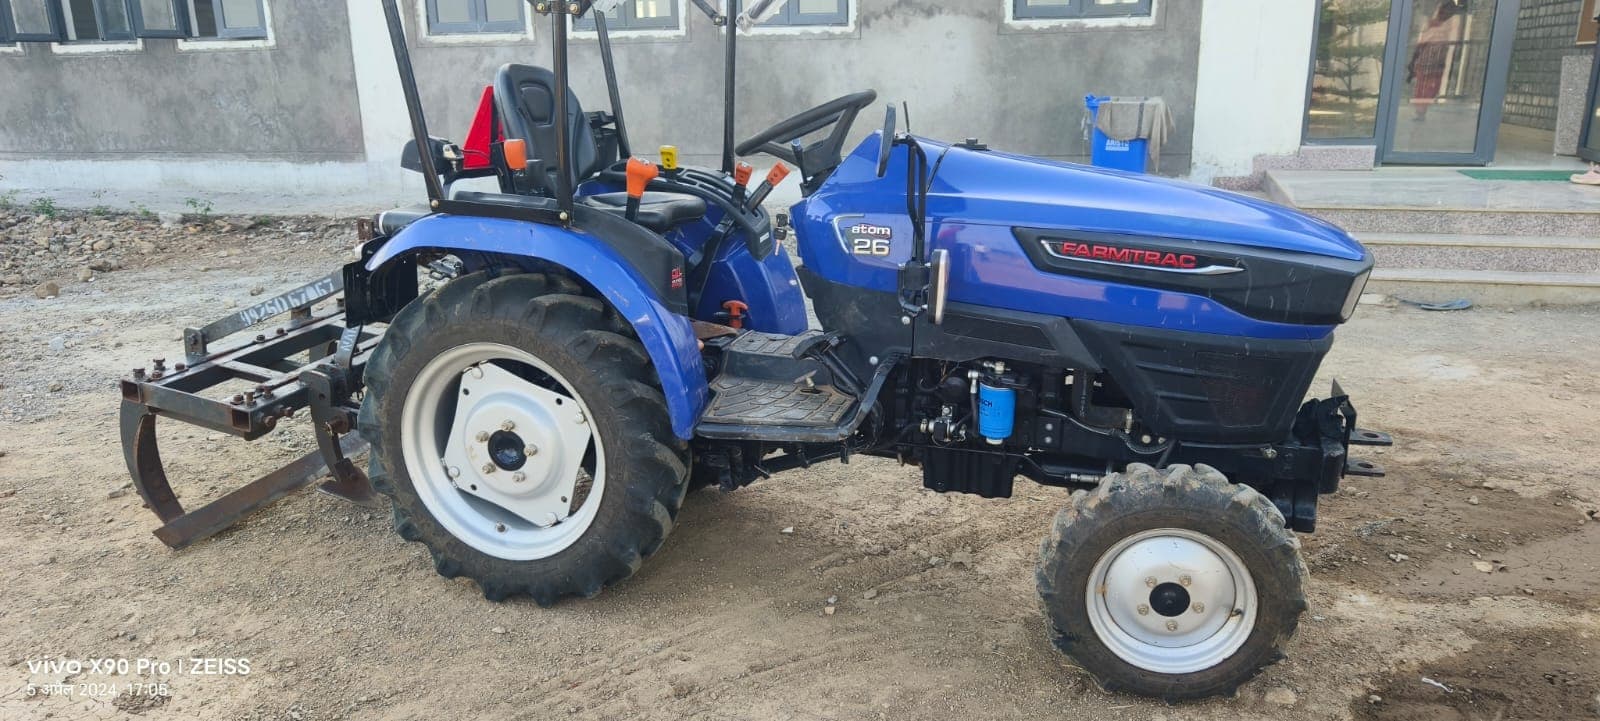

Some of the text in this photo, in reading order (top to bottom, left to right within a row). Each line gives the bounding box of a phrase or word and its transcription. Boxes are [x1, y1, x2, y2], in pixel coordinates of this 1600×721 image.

[851, 224, 891, 238] atom
[854, 238, 890, 255] 26
[1061, 242, 1196, 268] FARMTRAC
